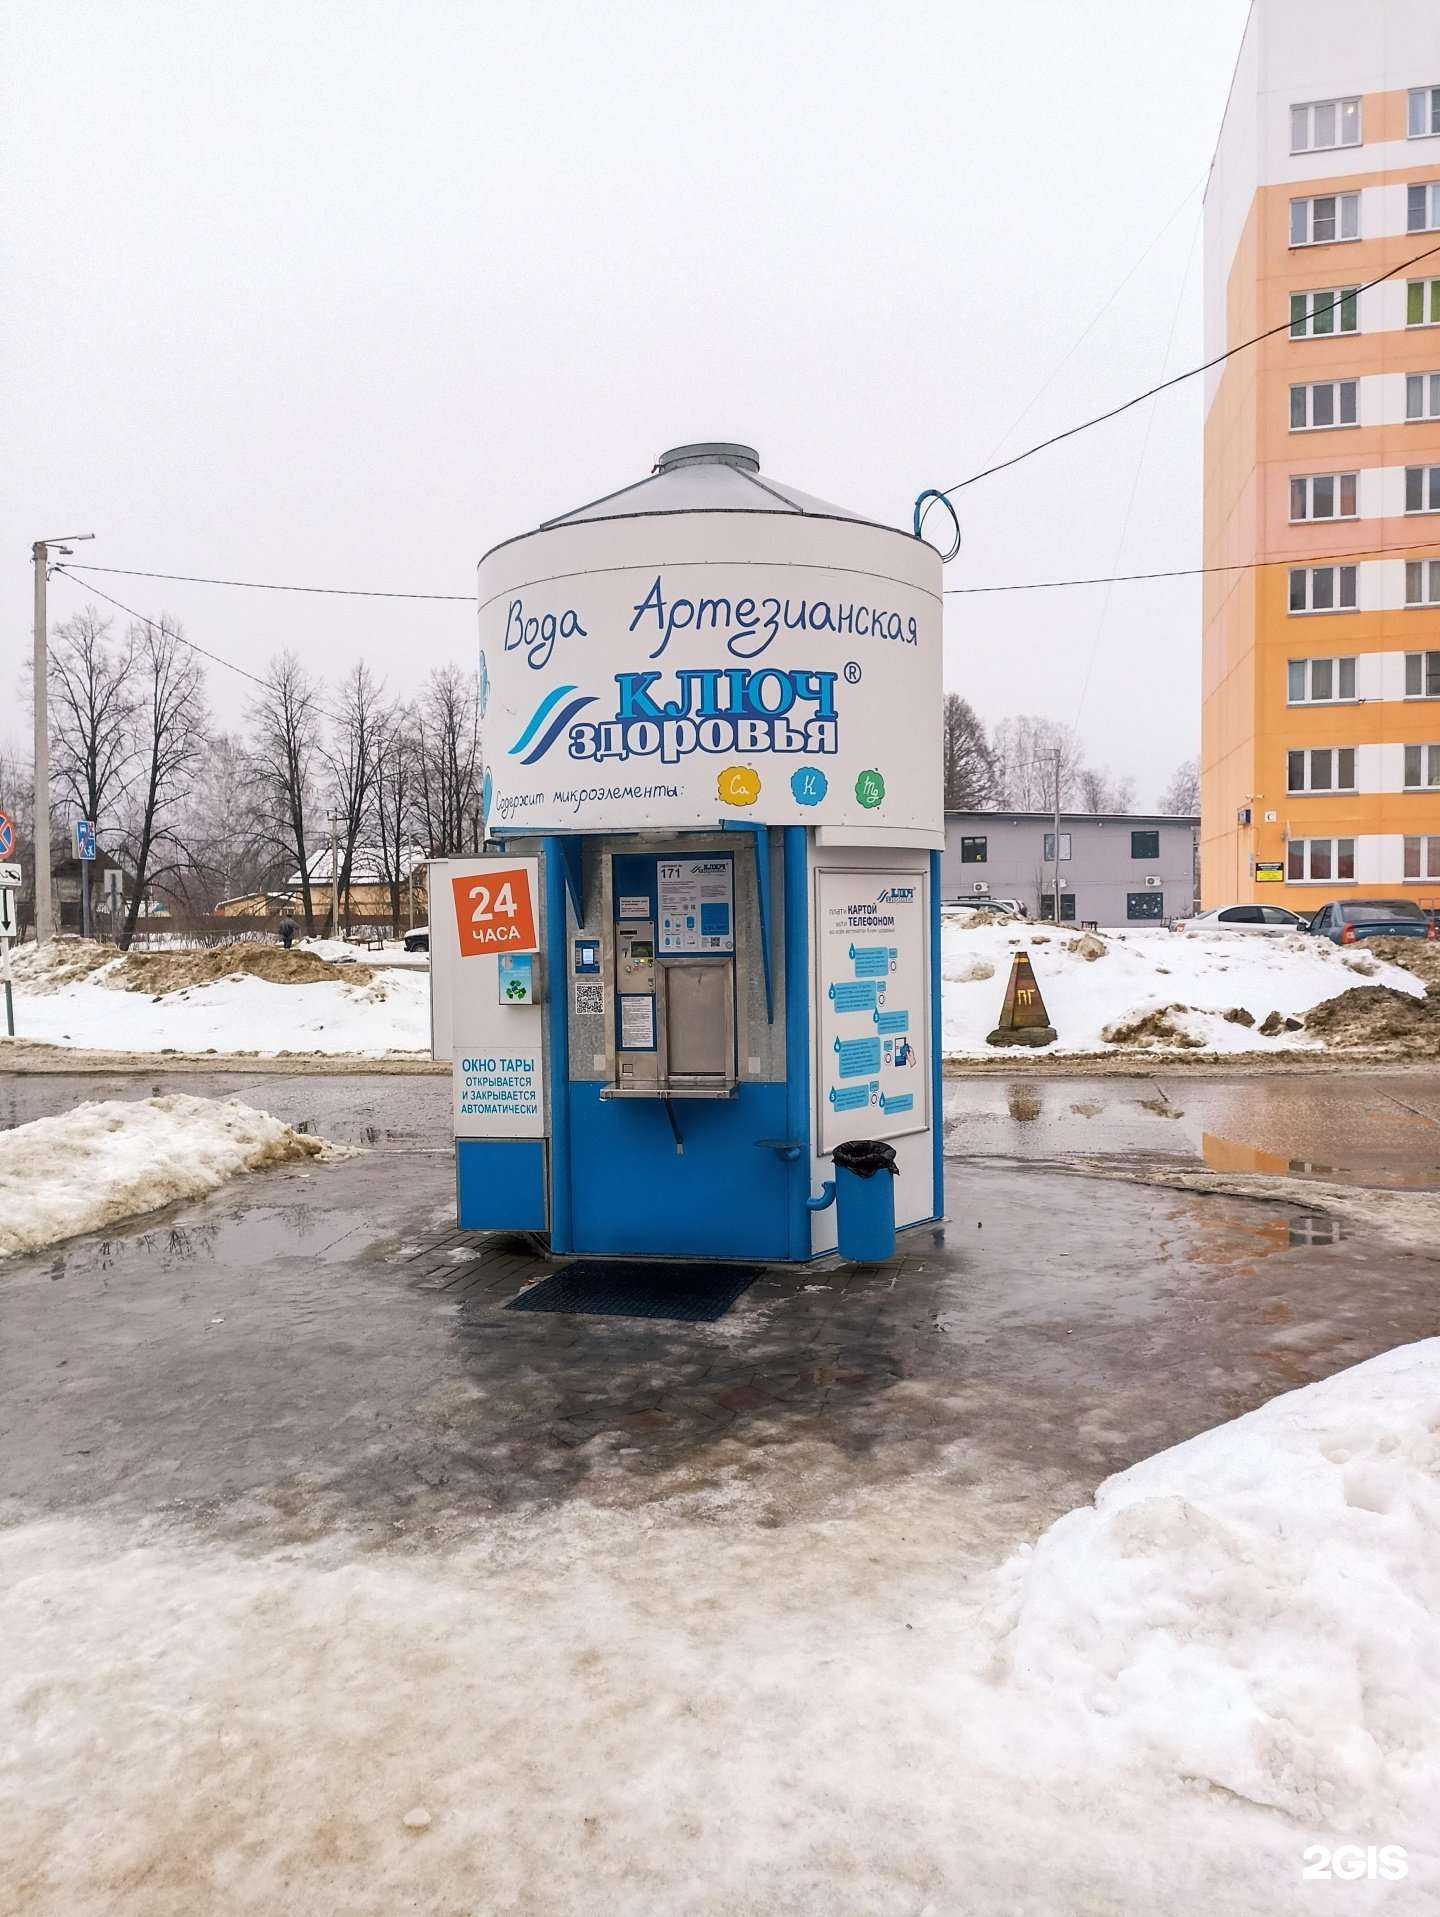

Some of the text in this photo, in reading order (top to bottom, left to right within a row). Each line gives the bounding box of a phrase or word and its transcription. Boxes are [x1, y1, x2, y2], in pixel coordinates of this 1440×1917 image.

[503, 575, 919, 670] Вода Артезианская
[614, 668, 838, 721] КЛЮЧ
[568, 716, 839, 763] здоровья
[496, 784, 685, 819] Содержит микроэлементы:
[661, 867, 680, 879] 171
[468, 882, 518, 923] 24
[847, 902, 877, 915] КАРТОЙ
[848, 916, 895, 927] ТЕЛЕФОНОМ
[472, 925, 521, 944] ЧАСА
[462, 1058, 535, 1073] ОКНО ТАРЫ
[465, 1076, 532, 1088] ОТКРЫВАЕТСЯ
[462, 1090, 536, 1101] И ЗАКРЫВАЕТСЯ
[461, 1103, 538, 1115] АВТОМАТИЧЕСКИ
